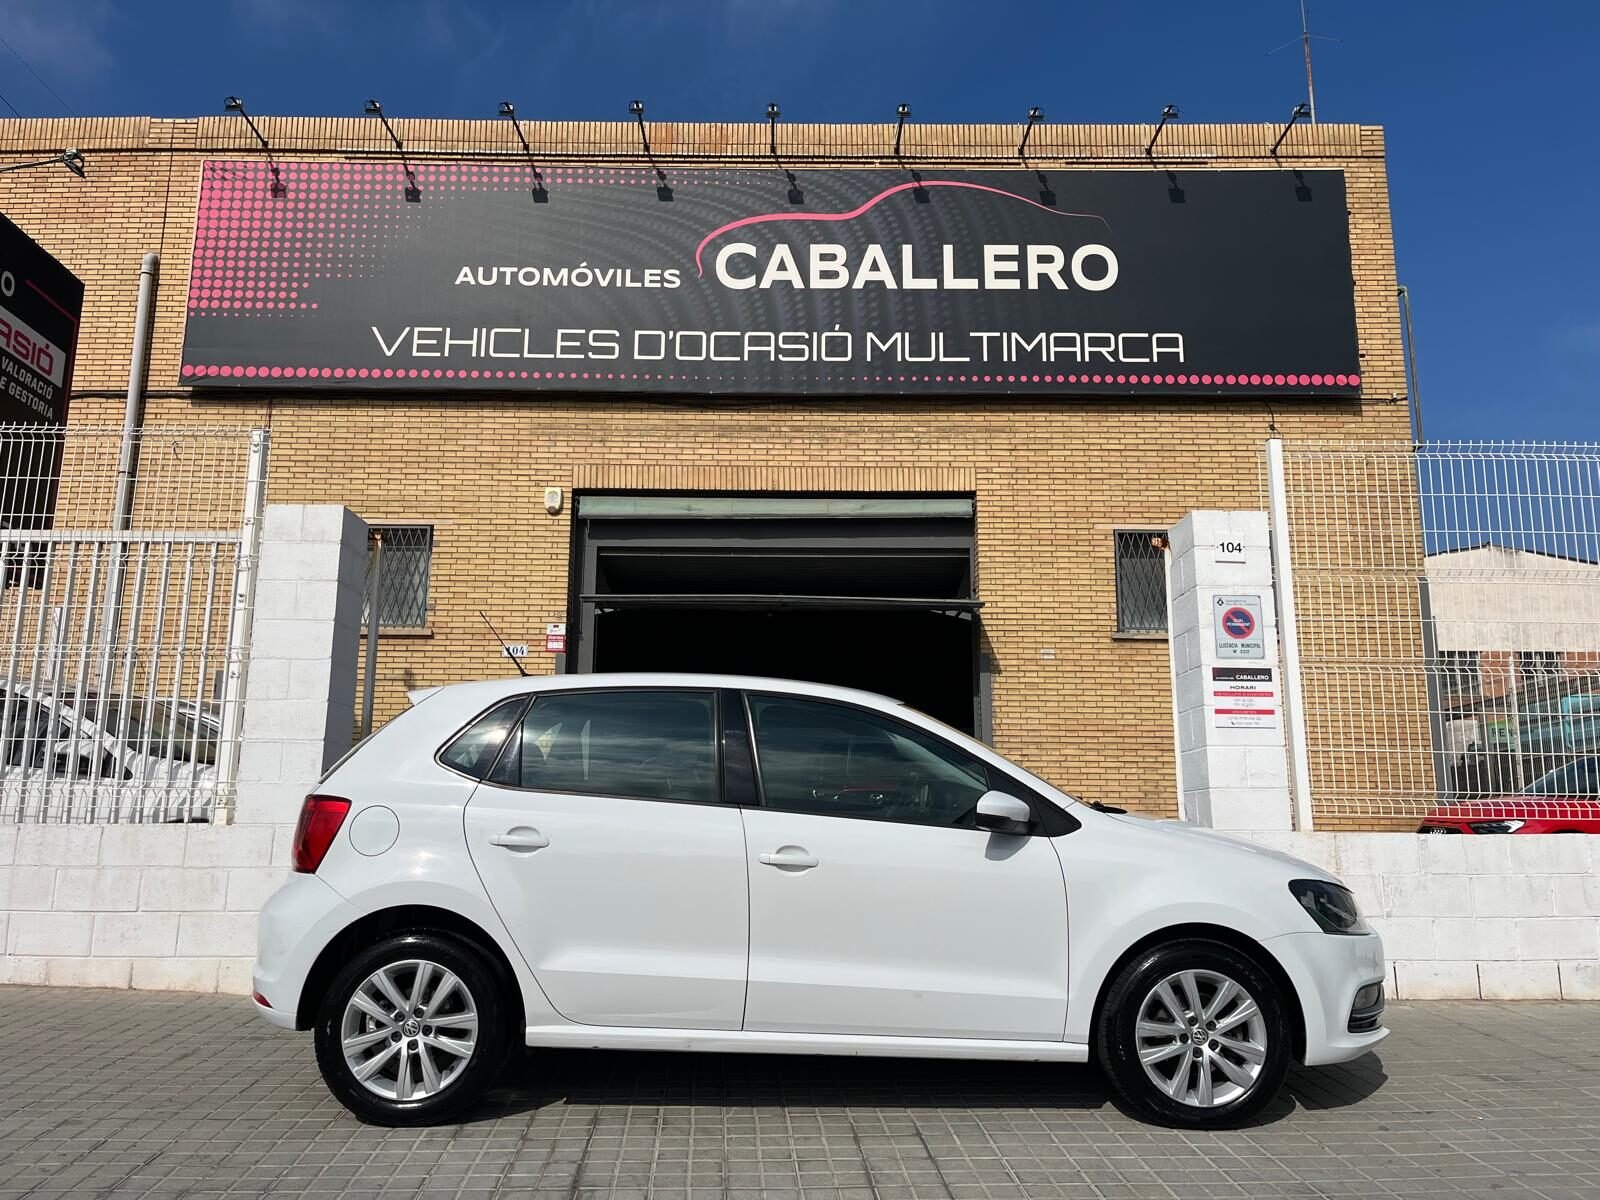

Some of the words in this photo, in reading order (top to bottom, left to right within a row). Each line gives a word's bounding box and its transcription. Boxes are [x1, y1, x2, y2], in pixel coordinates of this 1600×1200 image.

[455, 261, 681, 289] AUTOMÓVILES
[715, 243, 1119, 291] CABALLERO
[371, 326, 620, 360] VEHICLES
[633, 323, 853, 363] D'OCASIÓ
[866, 331, 1185, 363] MULTIMARCA
[1, 355, 54, 401] VALORACIÓ
[8, 381, 54, 421] GESTORIA
[1219, 541, 1243, 554] 104
